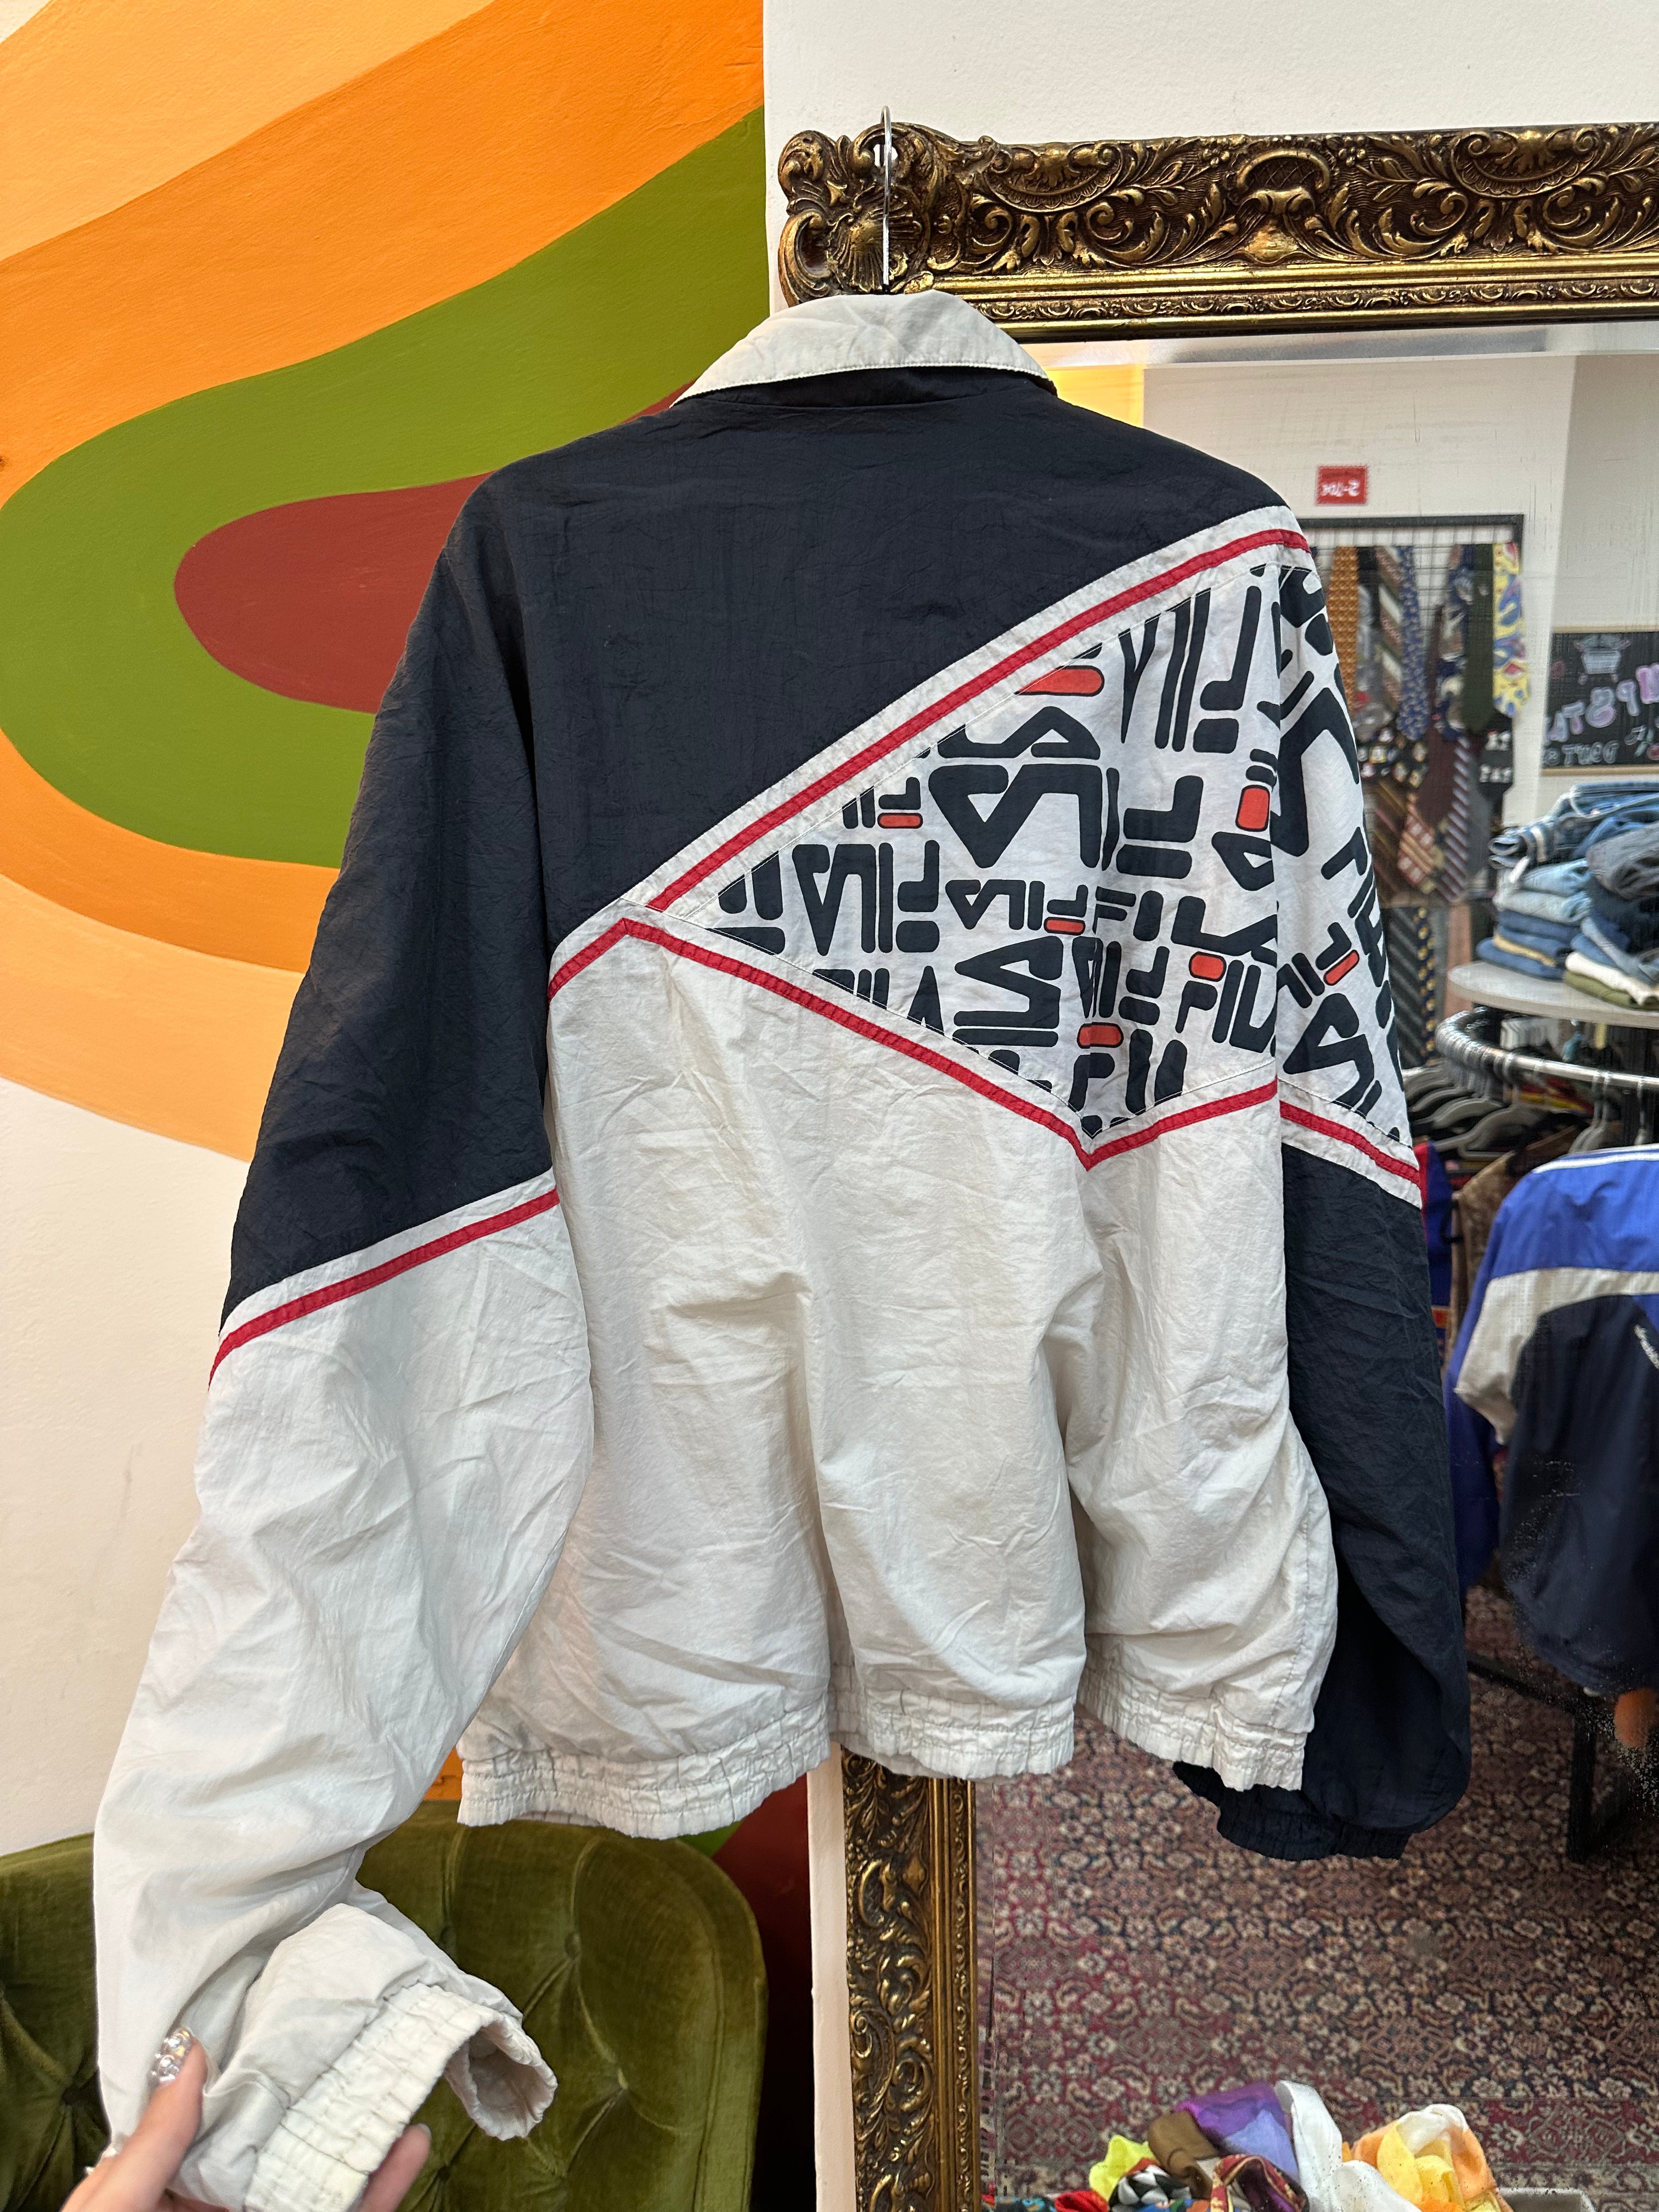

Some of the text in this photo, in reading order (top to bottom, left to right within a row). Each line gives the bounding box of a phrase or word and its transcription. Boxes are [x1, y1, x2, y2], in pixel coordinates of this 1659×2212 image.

[928, 763, 1204, 879] FILA
[792, 840, 940, 956] FILA
[945, 879, 1088, 936] FILA
